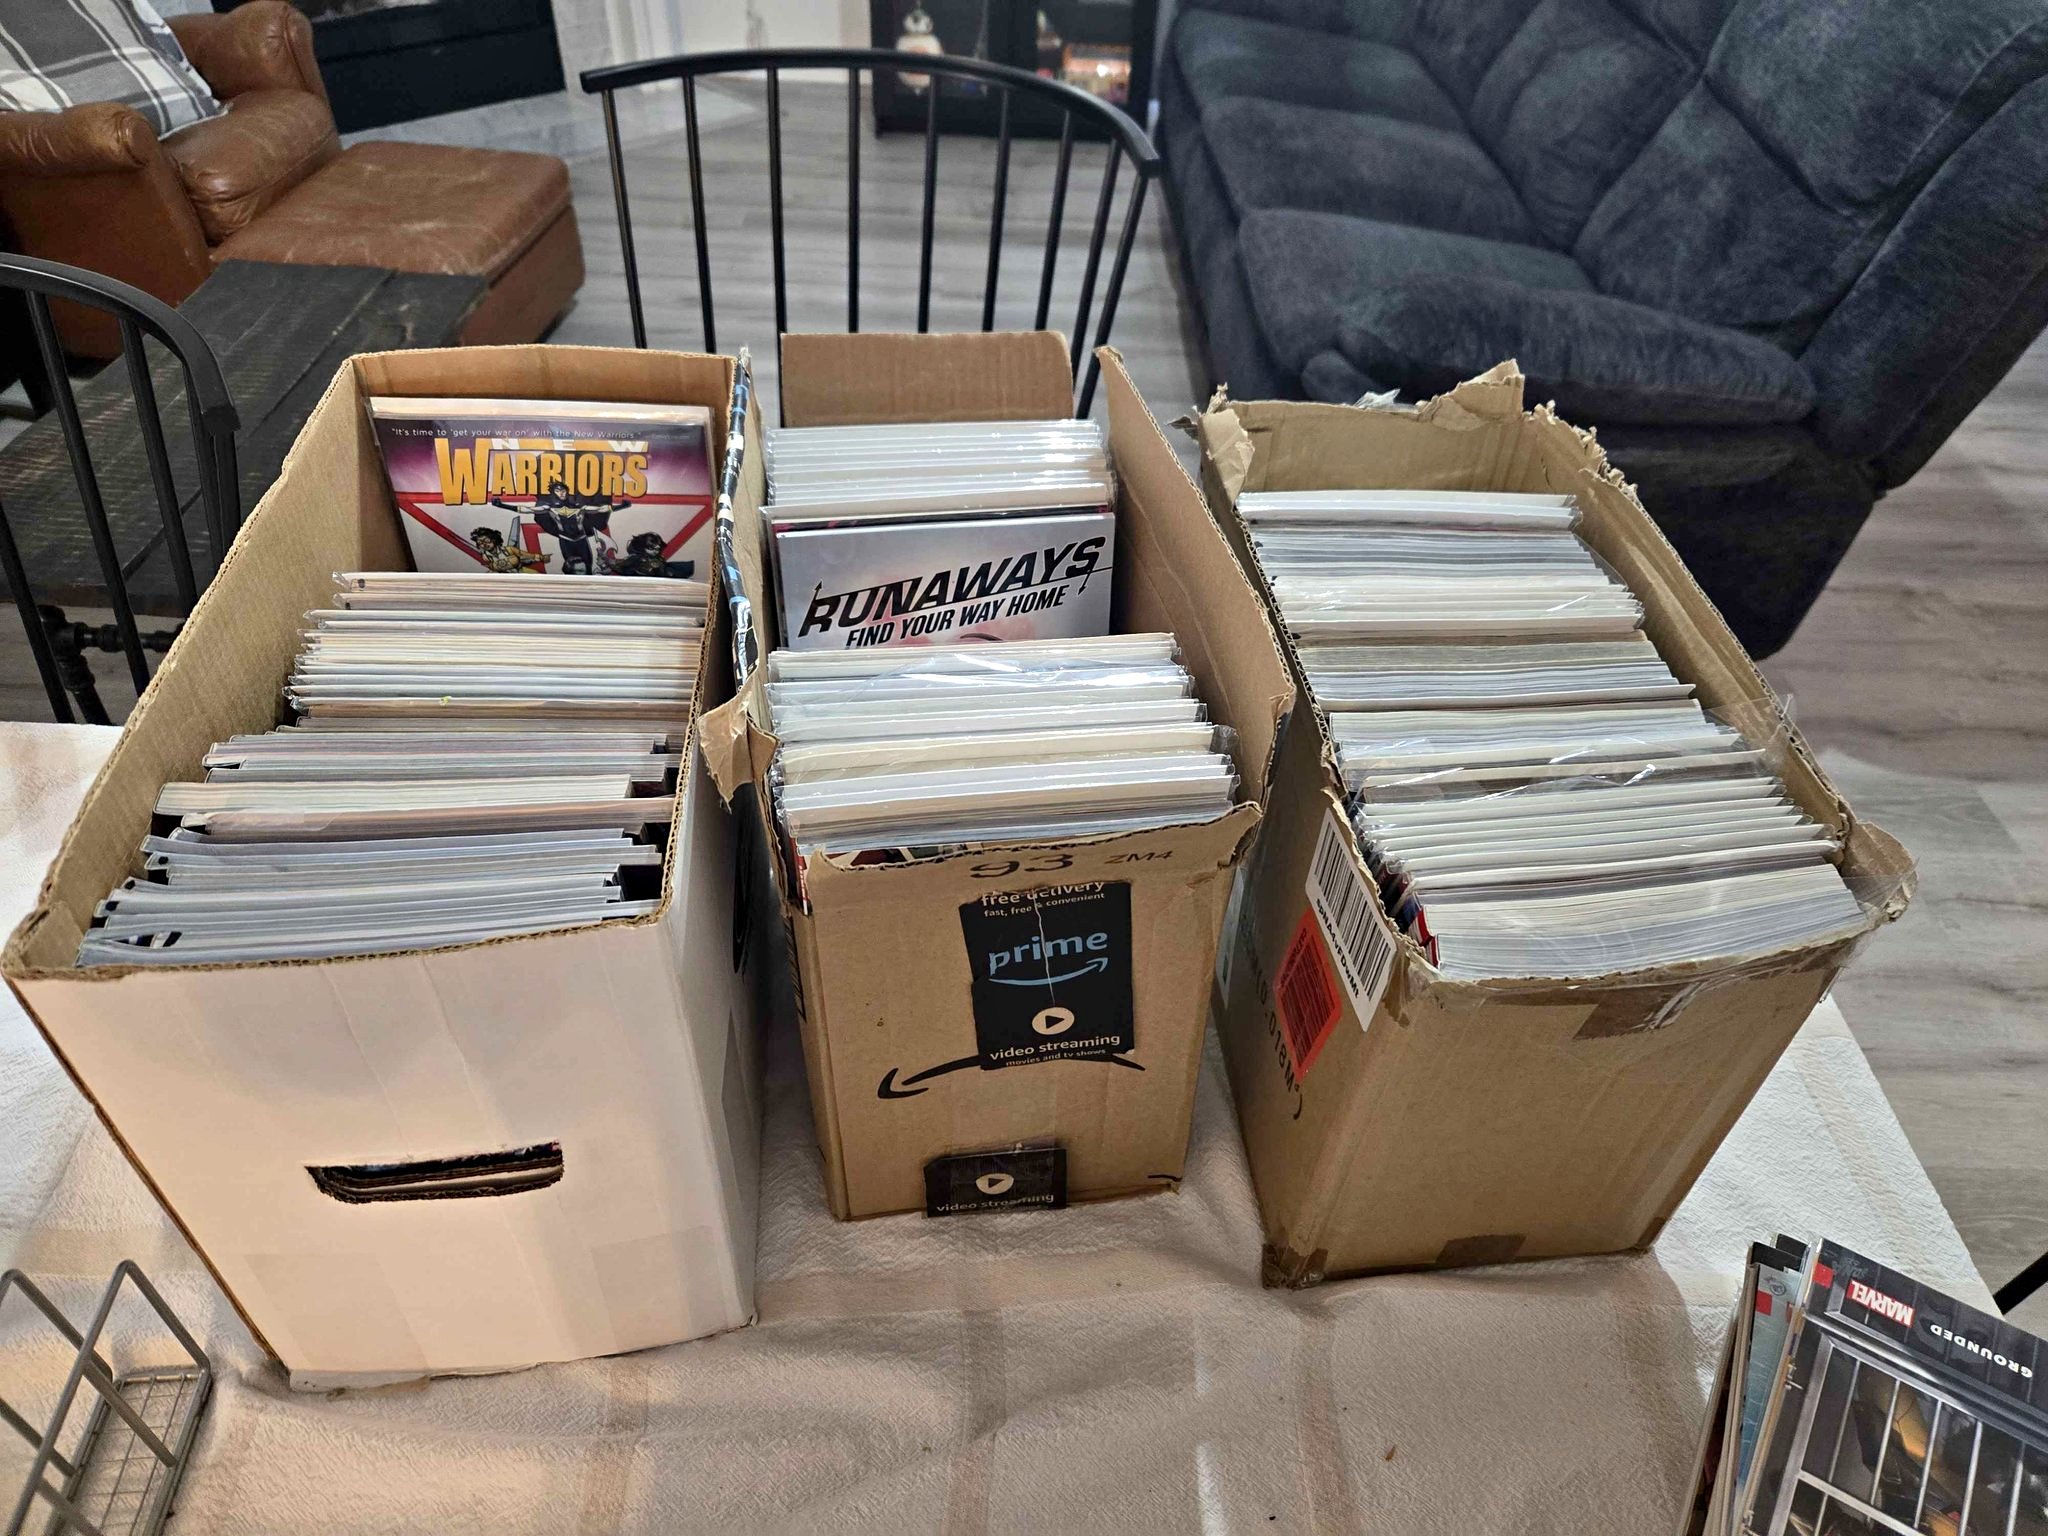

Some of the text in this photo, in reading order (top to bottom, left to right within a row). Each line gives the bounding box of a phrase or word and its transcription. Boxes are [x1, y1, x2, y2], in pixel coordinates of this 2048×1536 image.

[413, 428, 434, 437] time
[437, 429, 447, 437] to
[471, 430, 491, 438] your
[533, 429, 552, 437] with
[556, 429, 571, 438] the
[491, 438, 648, 452] NEW
[434, 438, 649, 506] WARRIORS
[798, 536, 1106, 639] RUNAWAYS
[845, 584, 1071, 650] FIND YOUR WAY HOME
[970, 853, 1074, 879] 93
[982, 893, 1021, 907] free
[984, 909, 1008, 918] fast,
[1011, 905, 1032, 914] free
[1046, 892, 1105, 907] convenient
[988, 931, 1109, 976] prime
[989, 1035, 1121, 1061] video streaming
[1006, 1048, 1107, 1067] movies and tv shows
[936, 1203, 977, 1212] video
[1850, 1279, 1914, 1327] MARVEL
[1930, 1323, 2034, 1379] GROUNDED
